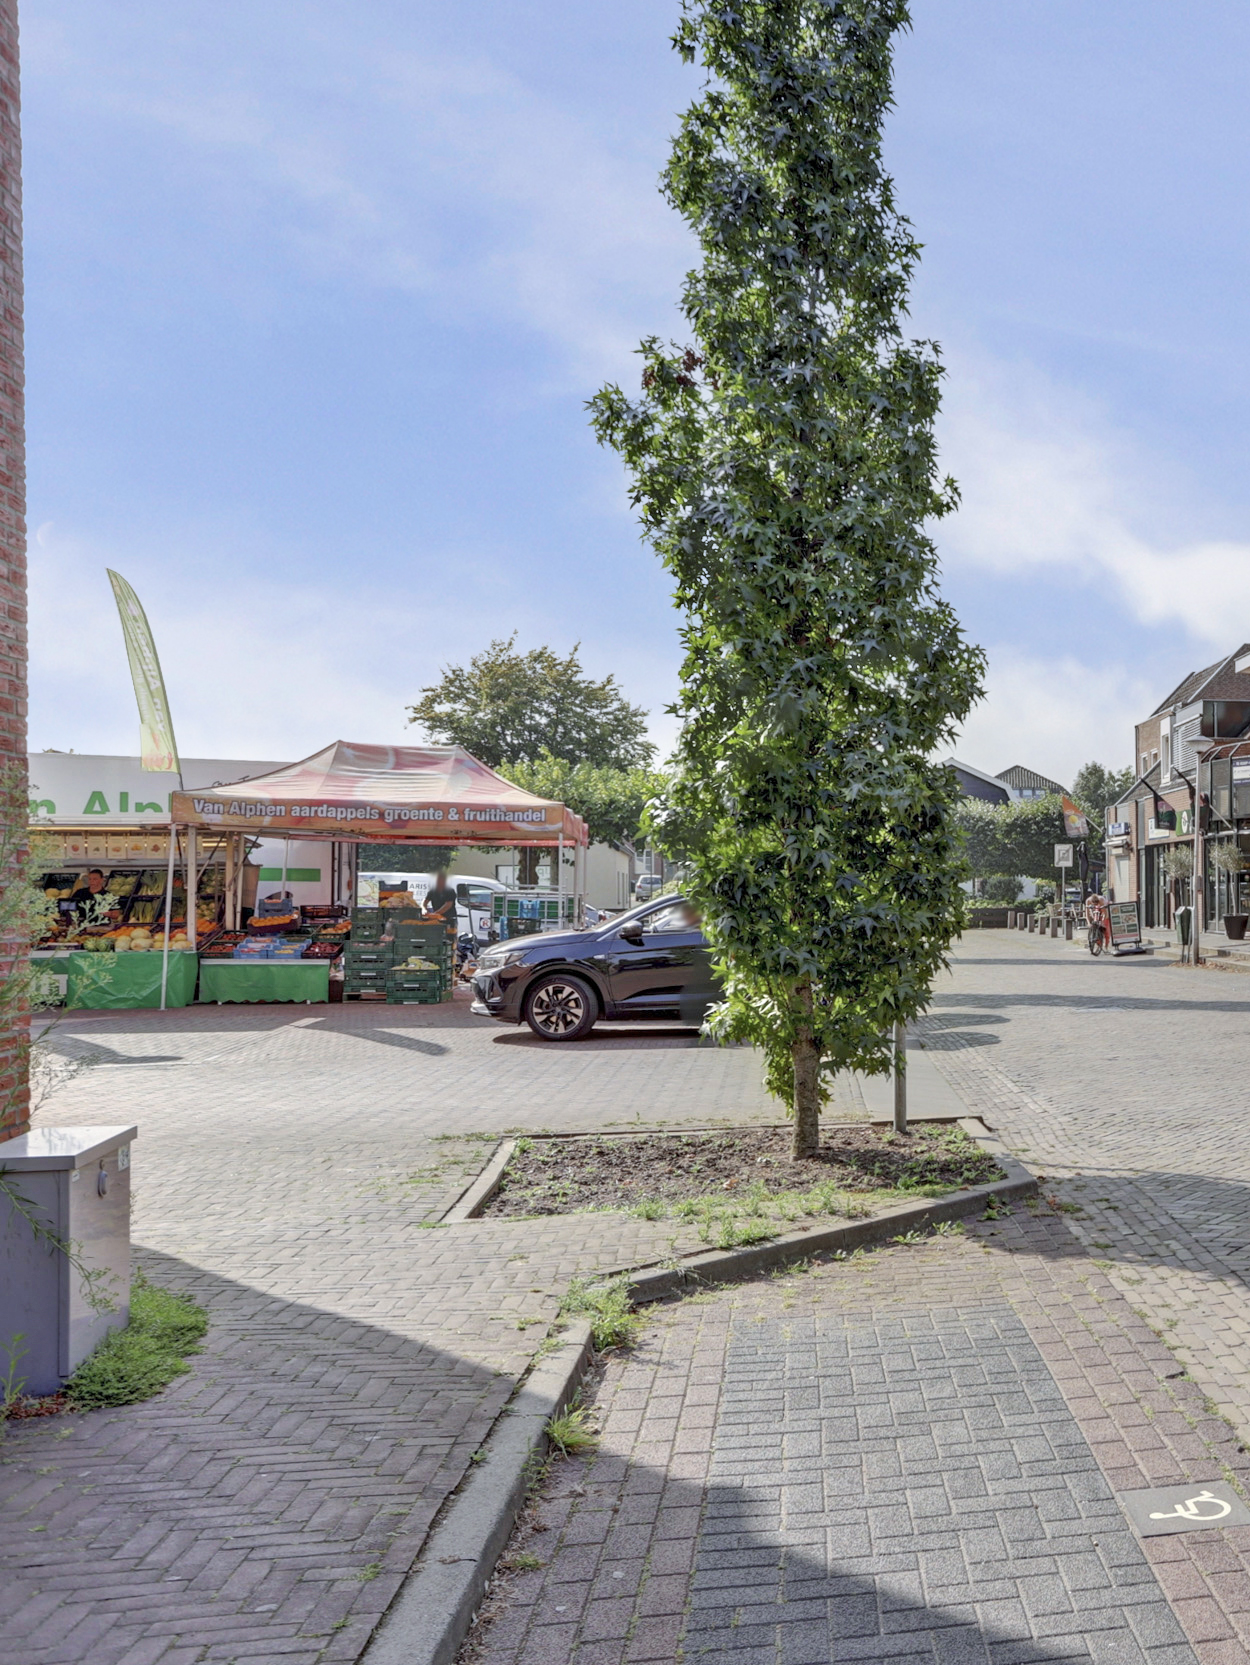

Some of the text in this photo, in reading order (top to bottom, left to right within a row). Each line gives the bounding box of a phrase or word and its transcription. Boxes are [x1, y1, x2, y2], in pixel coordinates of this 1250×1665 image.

[193, 799, 546, 823] Van Alphen aardappels groente & fruithandel
